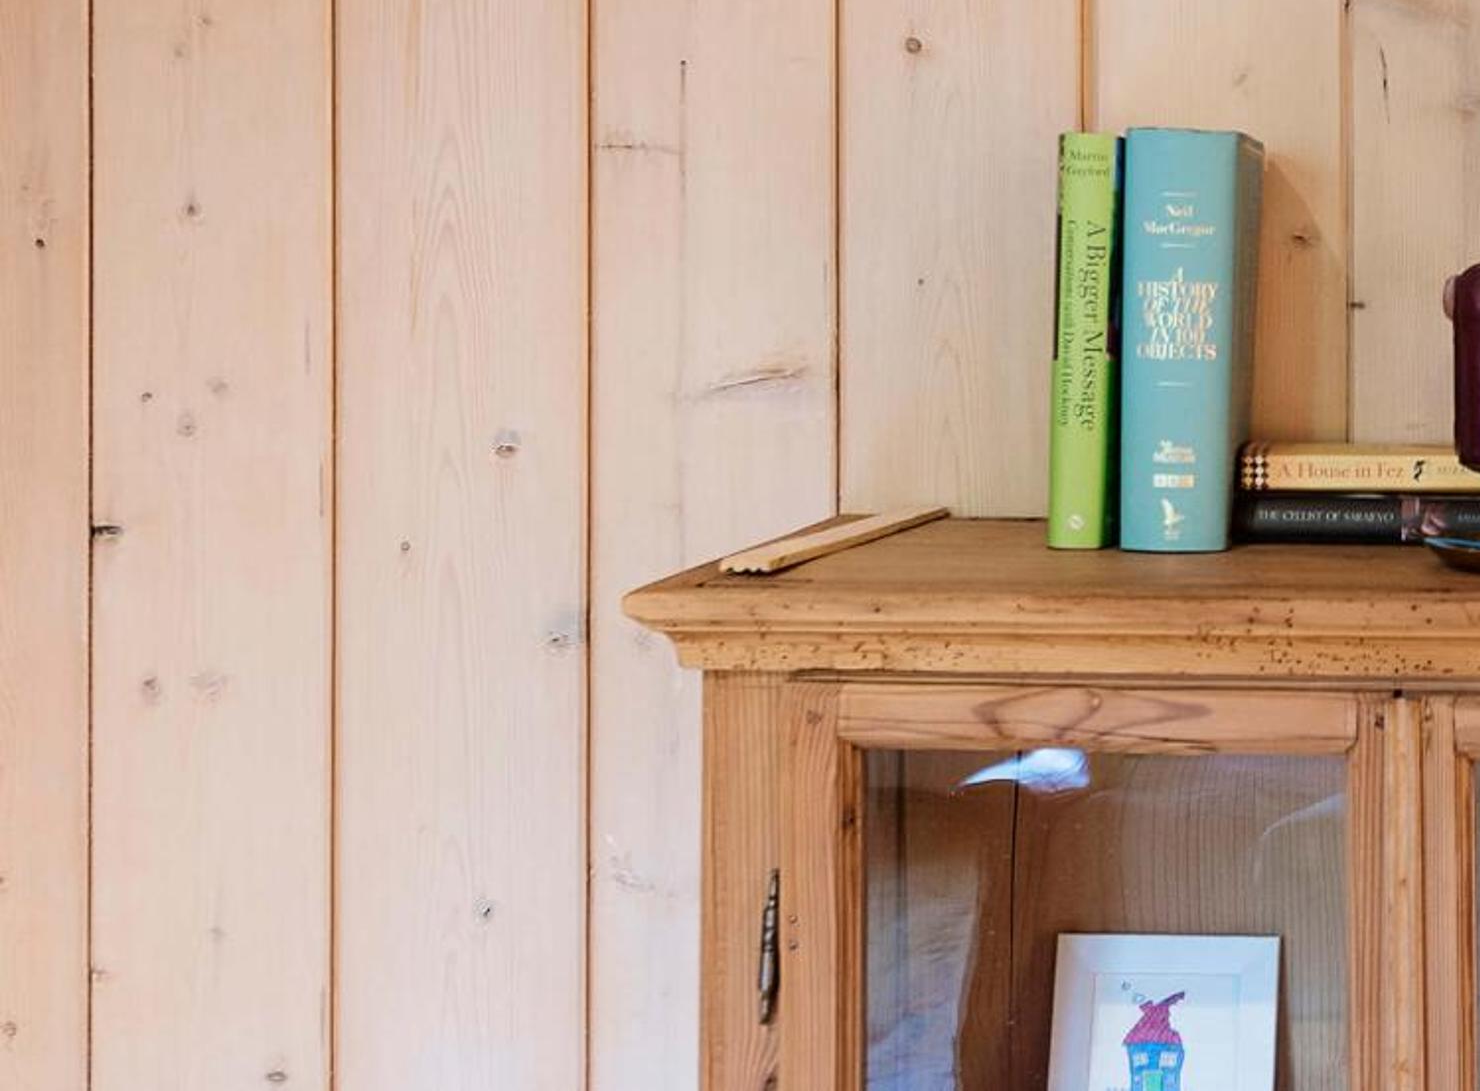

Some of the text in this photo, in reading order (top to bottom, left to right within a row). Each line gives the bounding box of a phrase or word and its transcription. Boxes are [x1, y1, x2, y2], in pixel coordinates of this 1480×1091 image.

[1074, 220, 1107, 432] A Bigger Message
[1278, 463, 1291, 479] A
[1298, 462, 1349, 479] House
[1376, 461, 1405, 479] Fez
